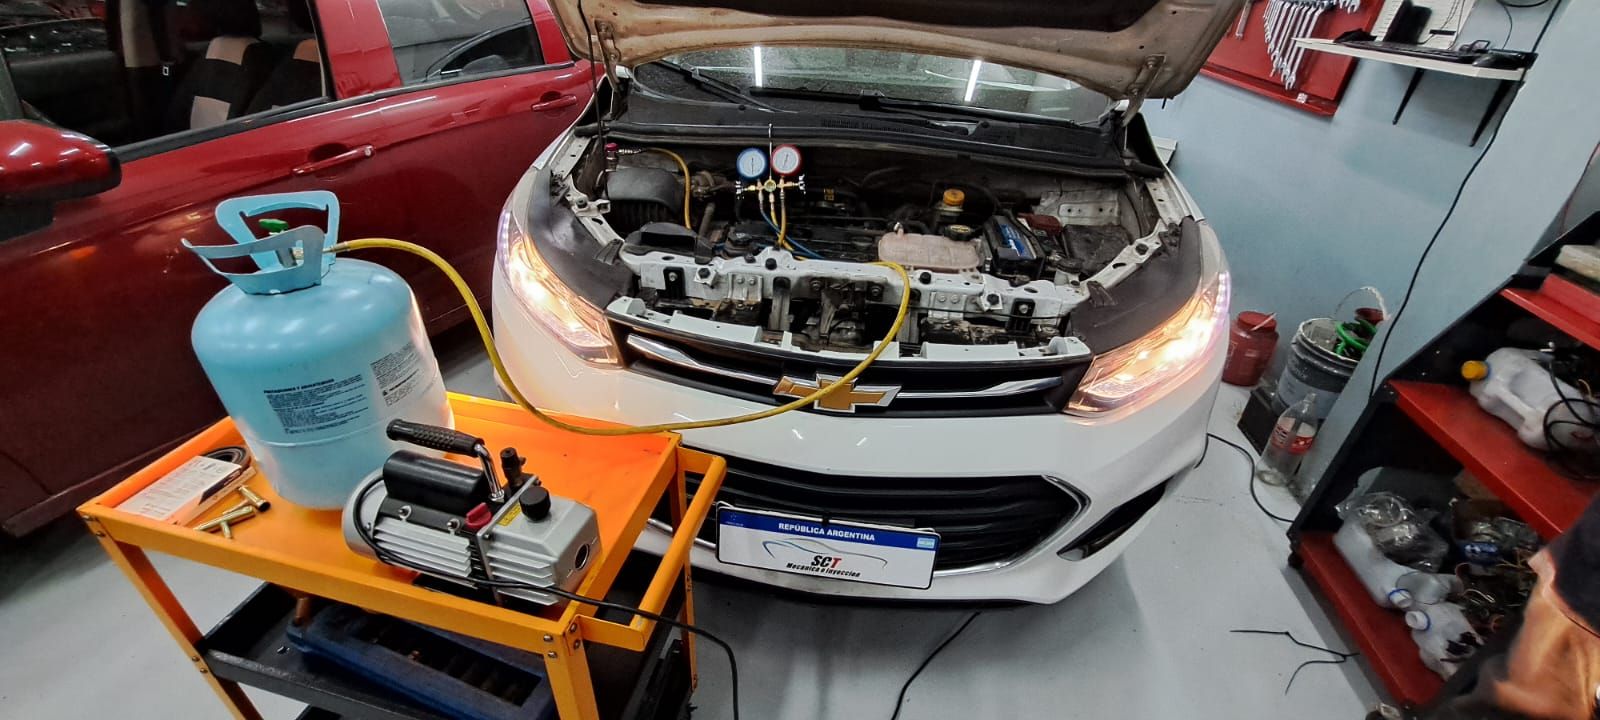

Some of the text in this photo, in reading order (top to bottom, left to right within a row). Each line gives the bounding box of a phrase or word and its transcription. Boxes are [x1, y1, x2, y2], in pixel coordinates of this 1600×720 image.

[779, 523, 875, 541] REPÚBLICA ARGENTINA
[811, 555, 842, 568] SCT
